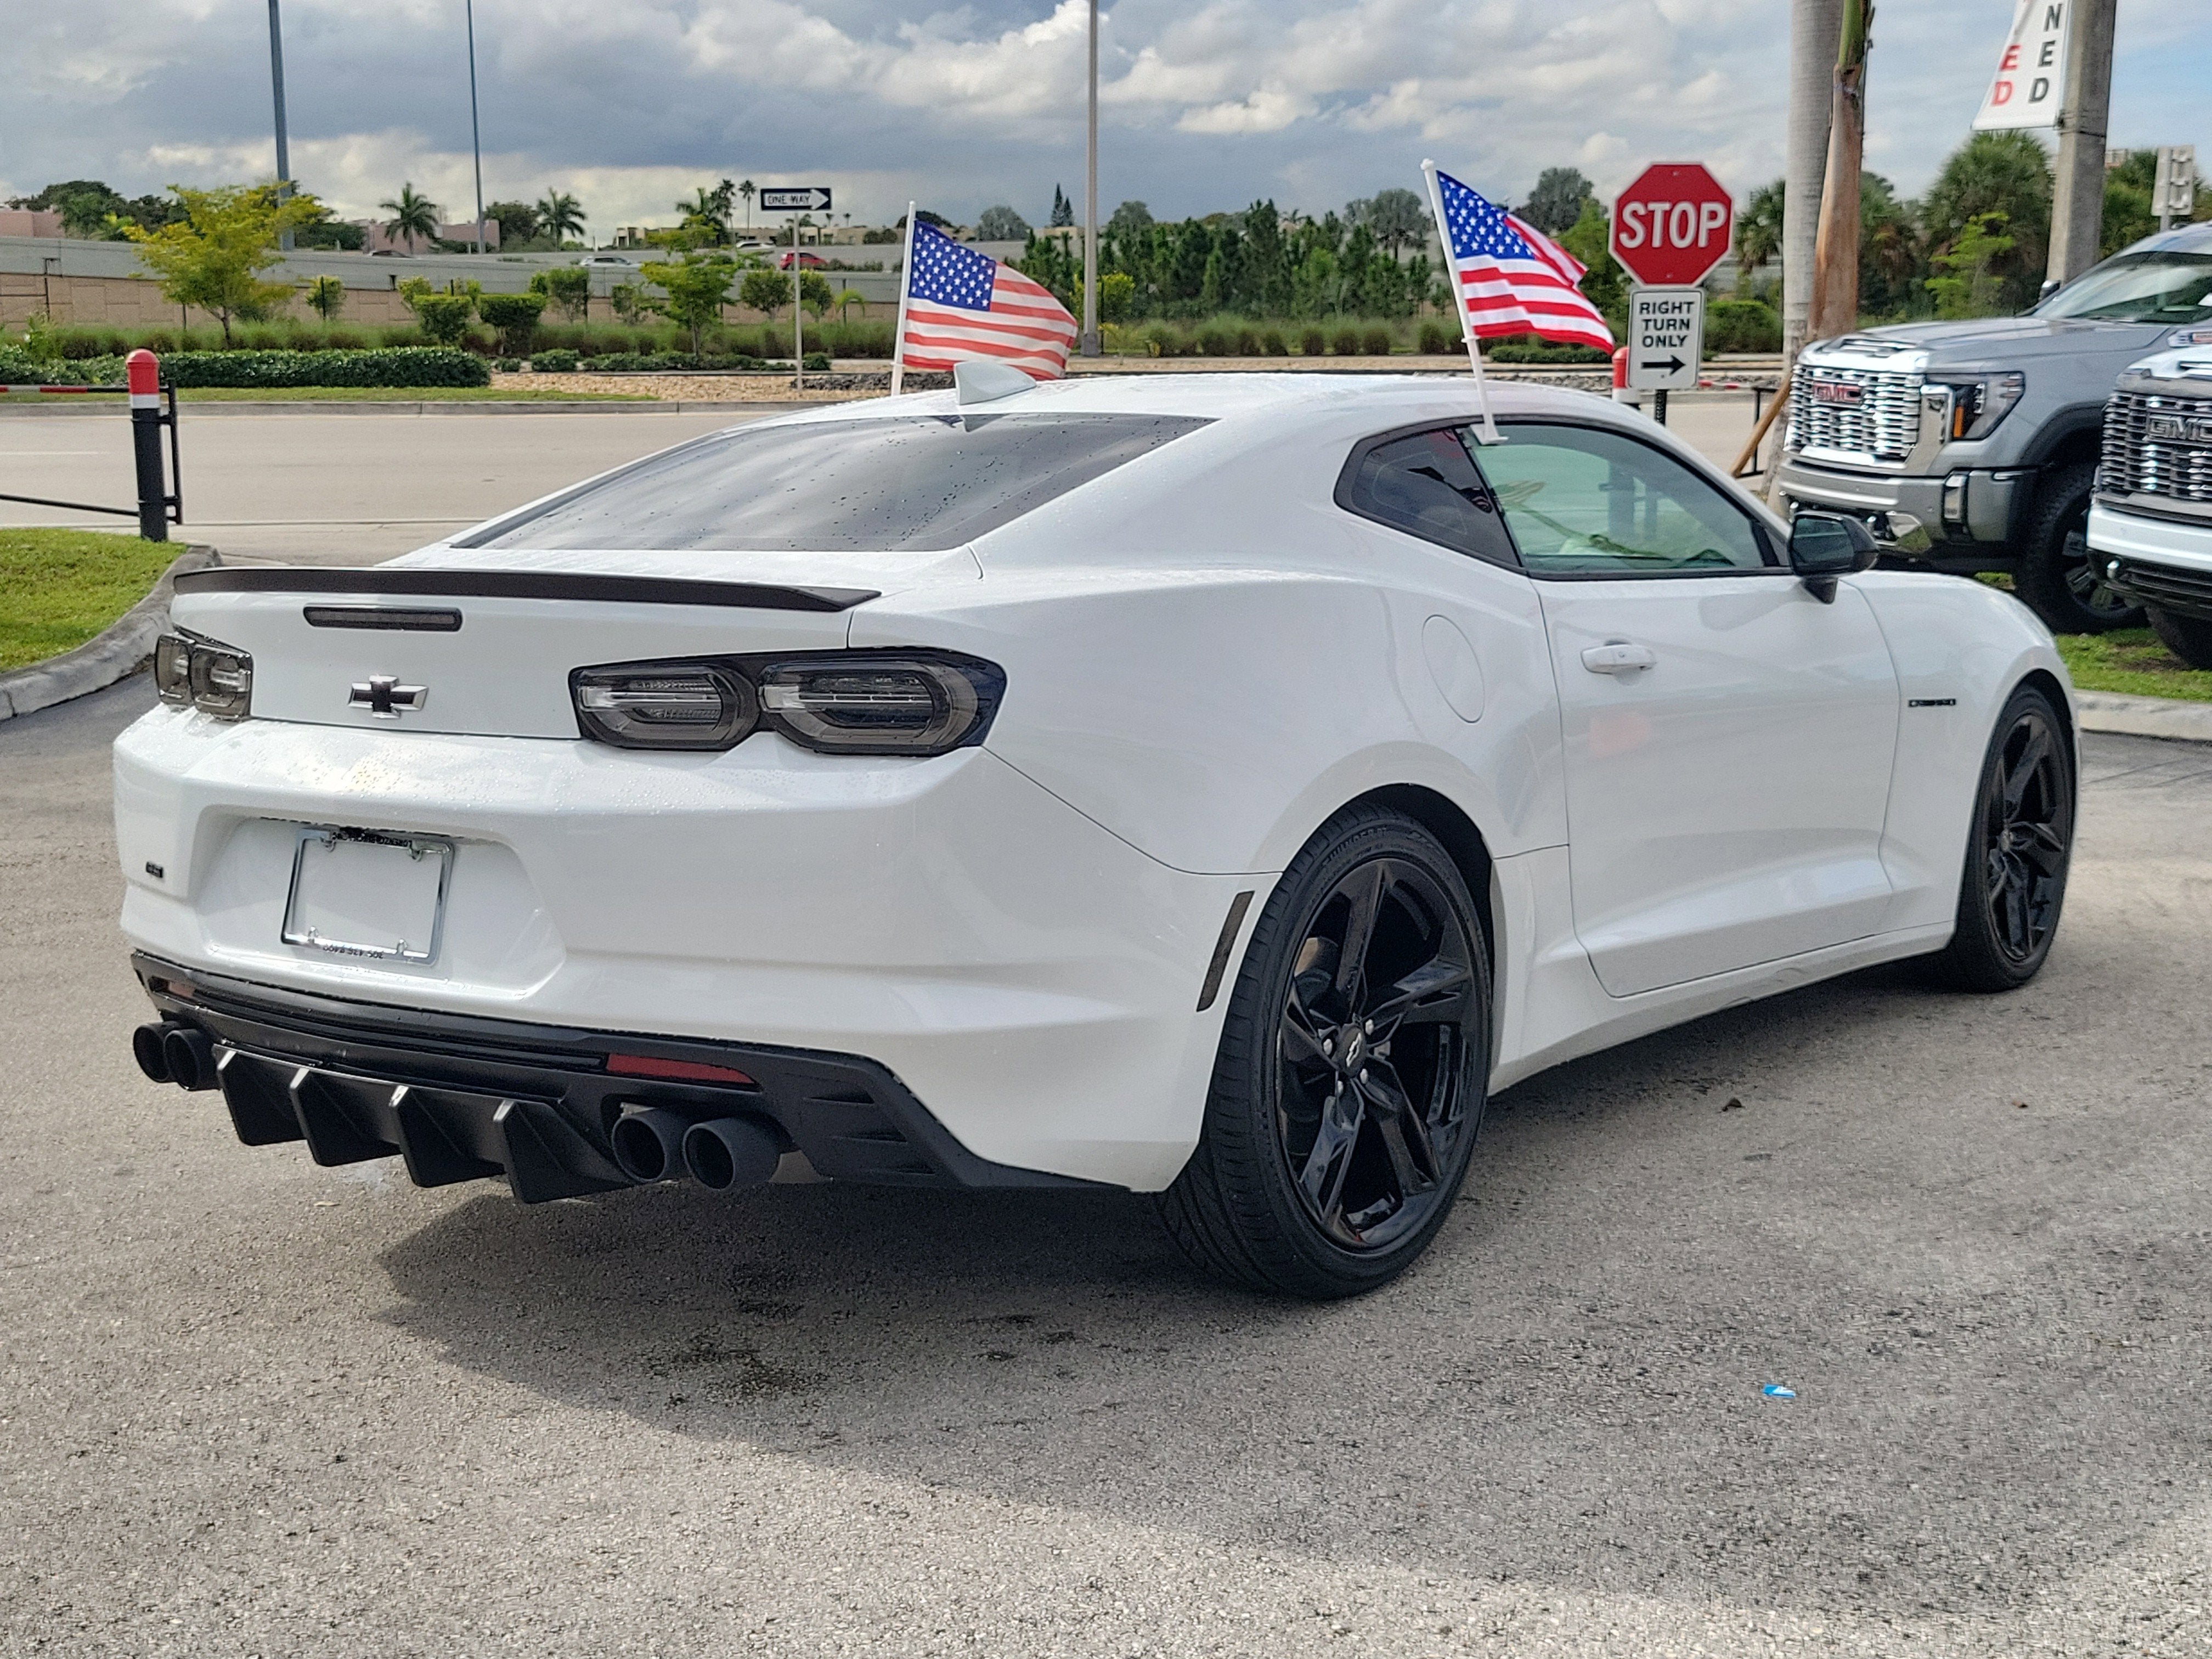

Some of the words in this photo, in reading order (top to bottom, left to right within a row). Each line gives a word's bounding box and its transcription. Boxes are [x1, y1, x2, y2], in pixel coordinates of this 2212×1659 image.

[768, 195, 786, 205] ONE
[790, 194, 811, 205] WAY
[1619, 201, 1728, 248] STOP
[1639, 301, 1695, 314] RIGHT
[1641, 318, 1690, 331] TURN
[1642, 335, 1688, 348] ONLY
[1813, 382, 1861, 403] GMC
